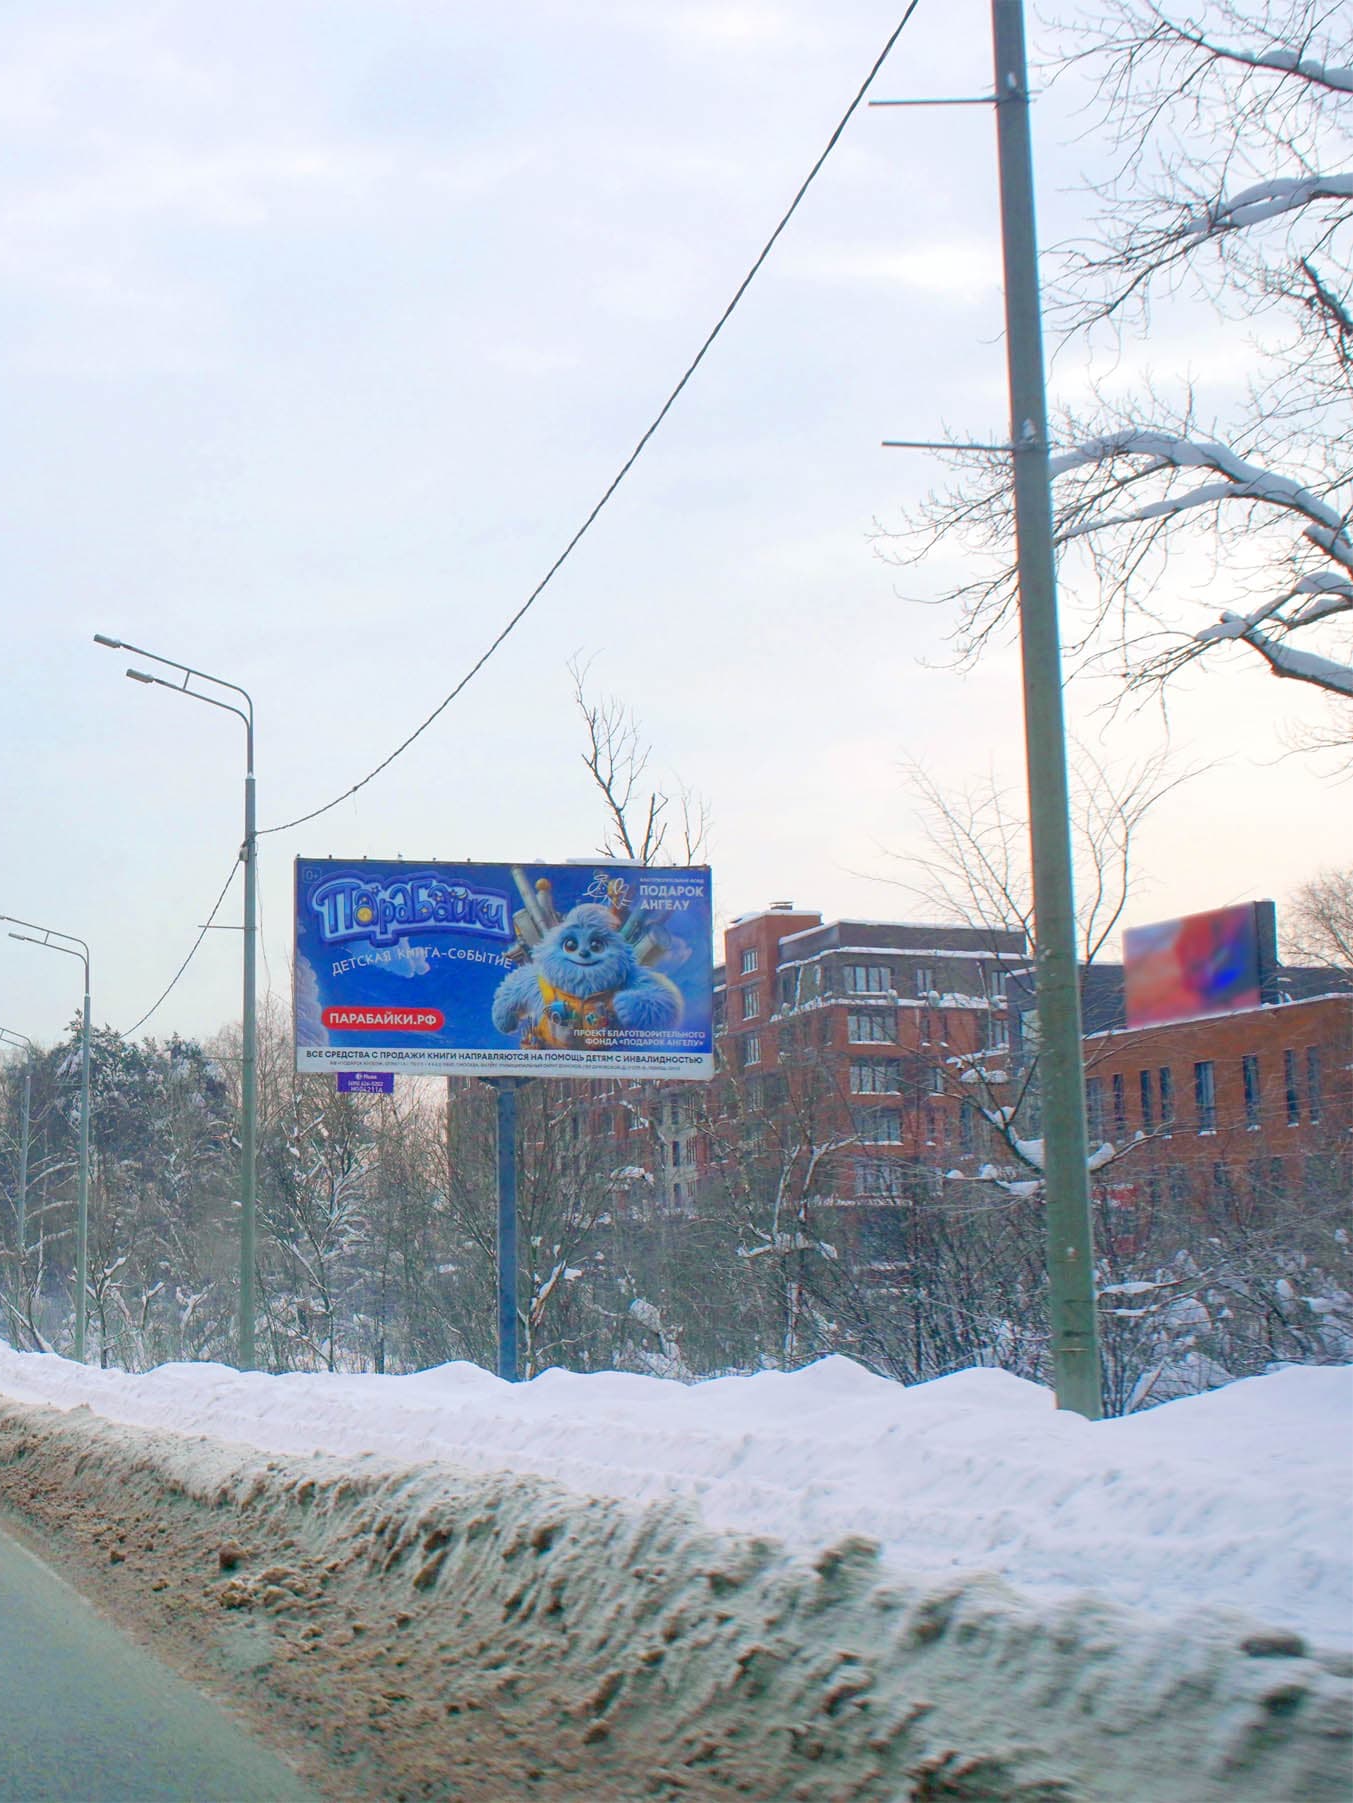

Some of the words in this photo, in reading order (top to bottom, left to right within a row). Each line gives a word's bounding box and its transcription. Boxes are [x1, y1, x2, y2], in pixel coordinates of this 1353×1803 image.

[305, 870, 319, 881] 0+
[639, 885, 704, 897] ПОДАРОК
[640, 899, 690, 910] АНГЕЛУ
[331, 950, 392, 976] ДЕТСКАЯ
[398, 946, 513, 970] КНИГА-СОБЫТИЕ
[329, 1011, 437, 1026] ПАРАБАЙКИ.РФ
[573, 1029, 606, 1037] ПРОЕКТ
[607, 1030, 706, 1039] БЛАГОТВОРИТЕЛЬНОГО
[584, 1038, 618, 1046] ФОНДА
[306, 1050, 323, 1058] ВСЕ
[324, 1051, 370, 1059] СРЕДСТВА
[371, 1051, 379, 1059] С
[380, 1051, 425, 1060] ПРОДАЖИ
[427, 1052, 457, 1060] КНИГИ
[458, 1052, 530, 1061] НАПРАВЛЯЮТСЯ
[531, 1053, 543, 1061] НА
[545, 1054, 584, 1062] ПОМОЩЬ
[586, 1055, 614, 1063] ДЕТЯМ
[615, 1055, 621, 1063] С
[623, 1055, 704, 1064] ИНВАЛИДНОСТЬЮ
